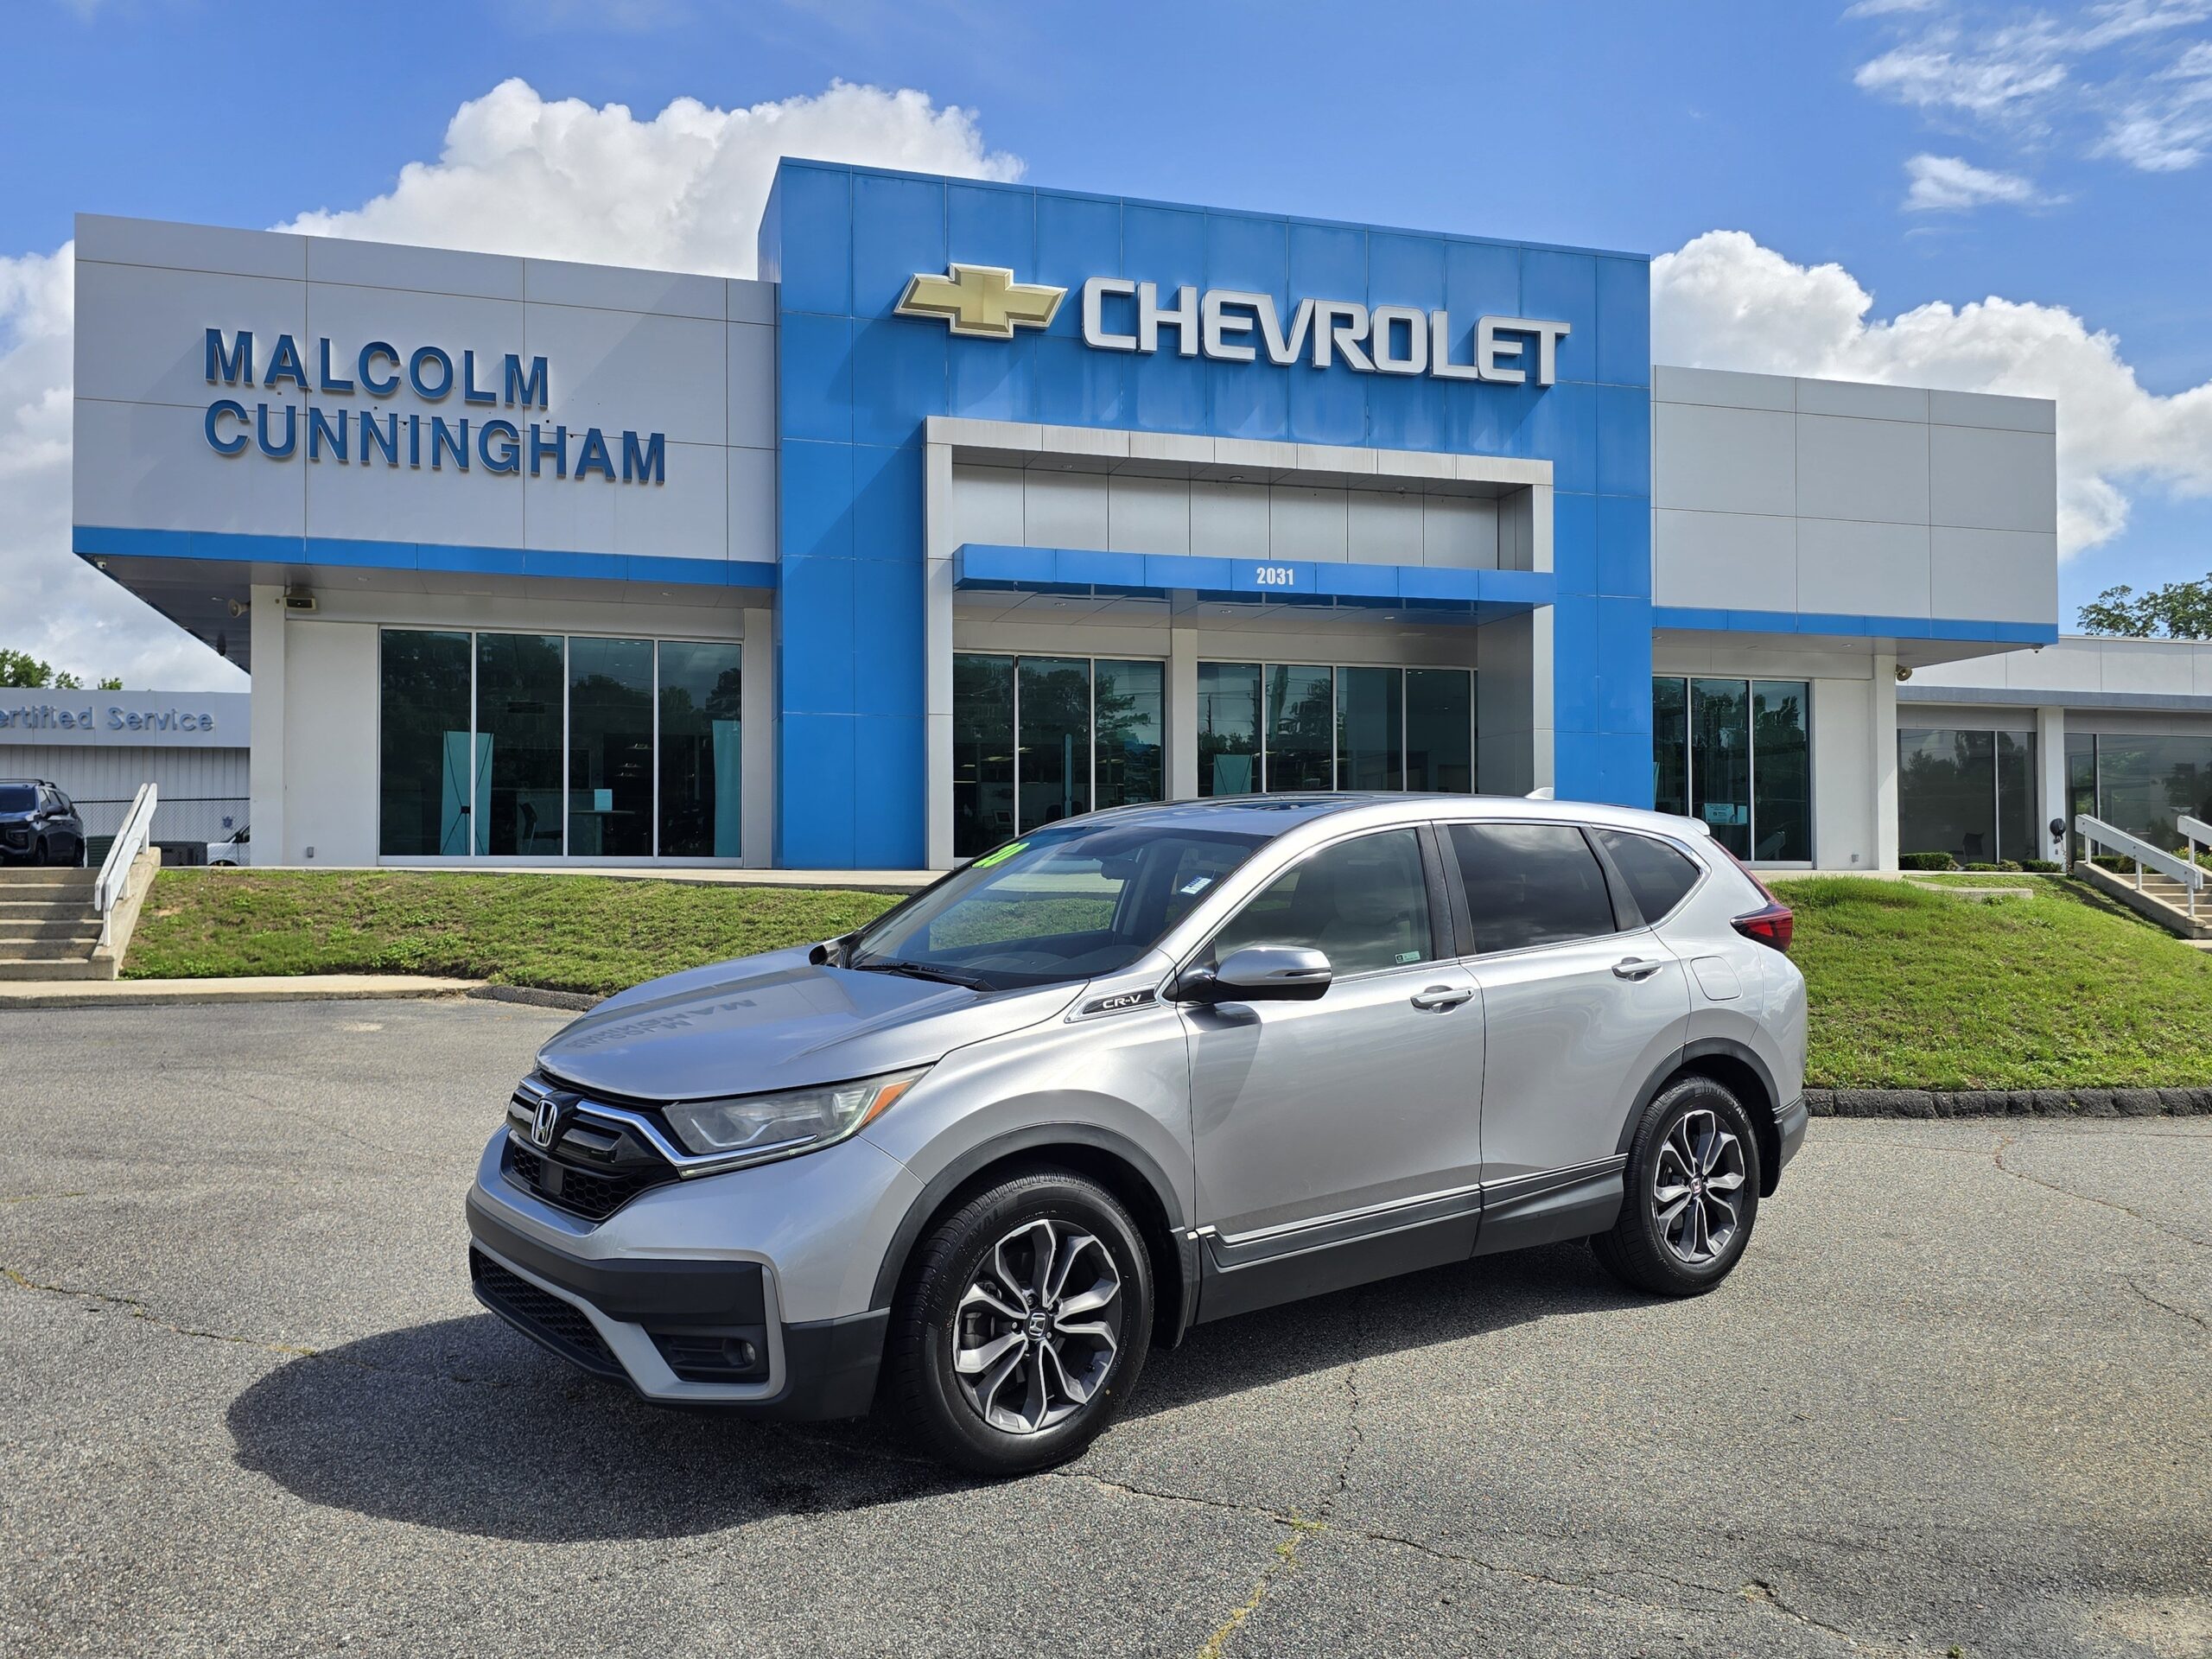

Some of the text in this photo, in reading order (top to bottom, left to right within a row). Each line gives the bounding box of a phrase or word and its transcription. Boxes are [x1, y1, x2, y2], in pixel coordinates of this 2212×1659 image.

[1082, 276, 1572, 387] CHEVROLET
[205, 327, 549, 410] MALCOLM
[204, 399, 665, 485] CUNNINGHAM
[1255, 567, 1294, 586] 2031
[107, 706, 214, 732] Service
[1102, 994, 1141, 1009] CR-V
